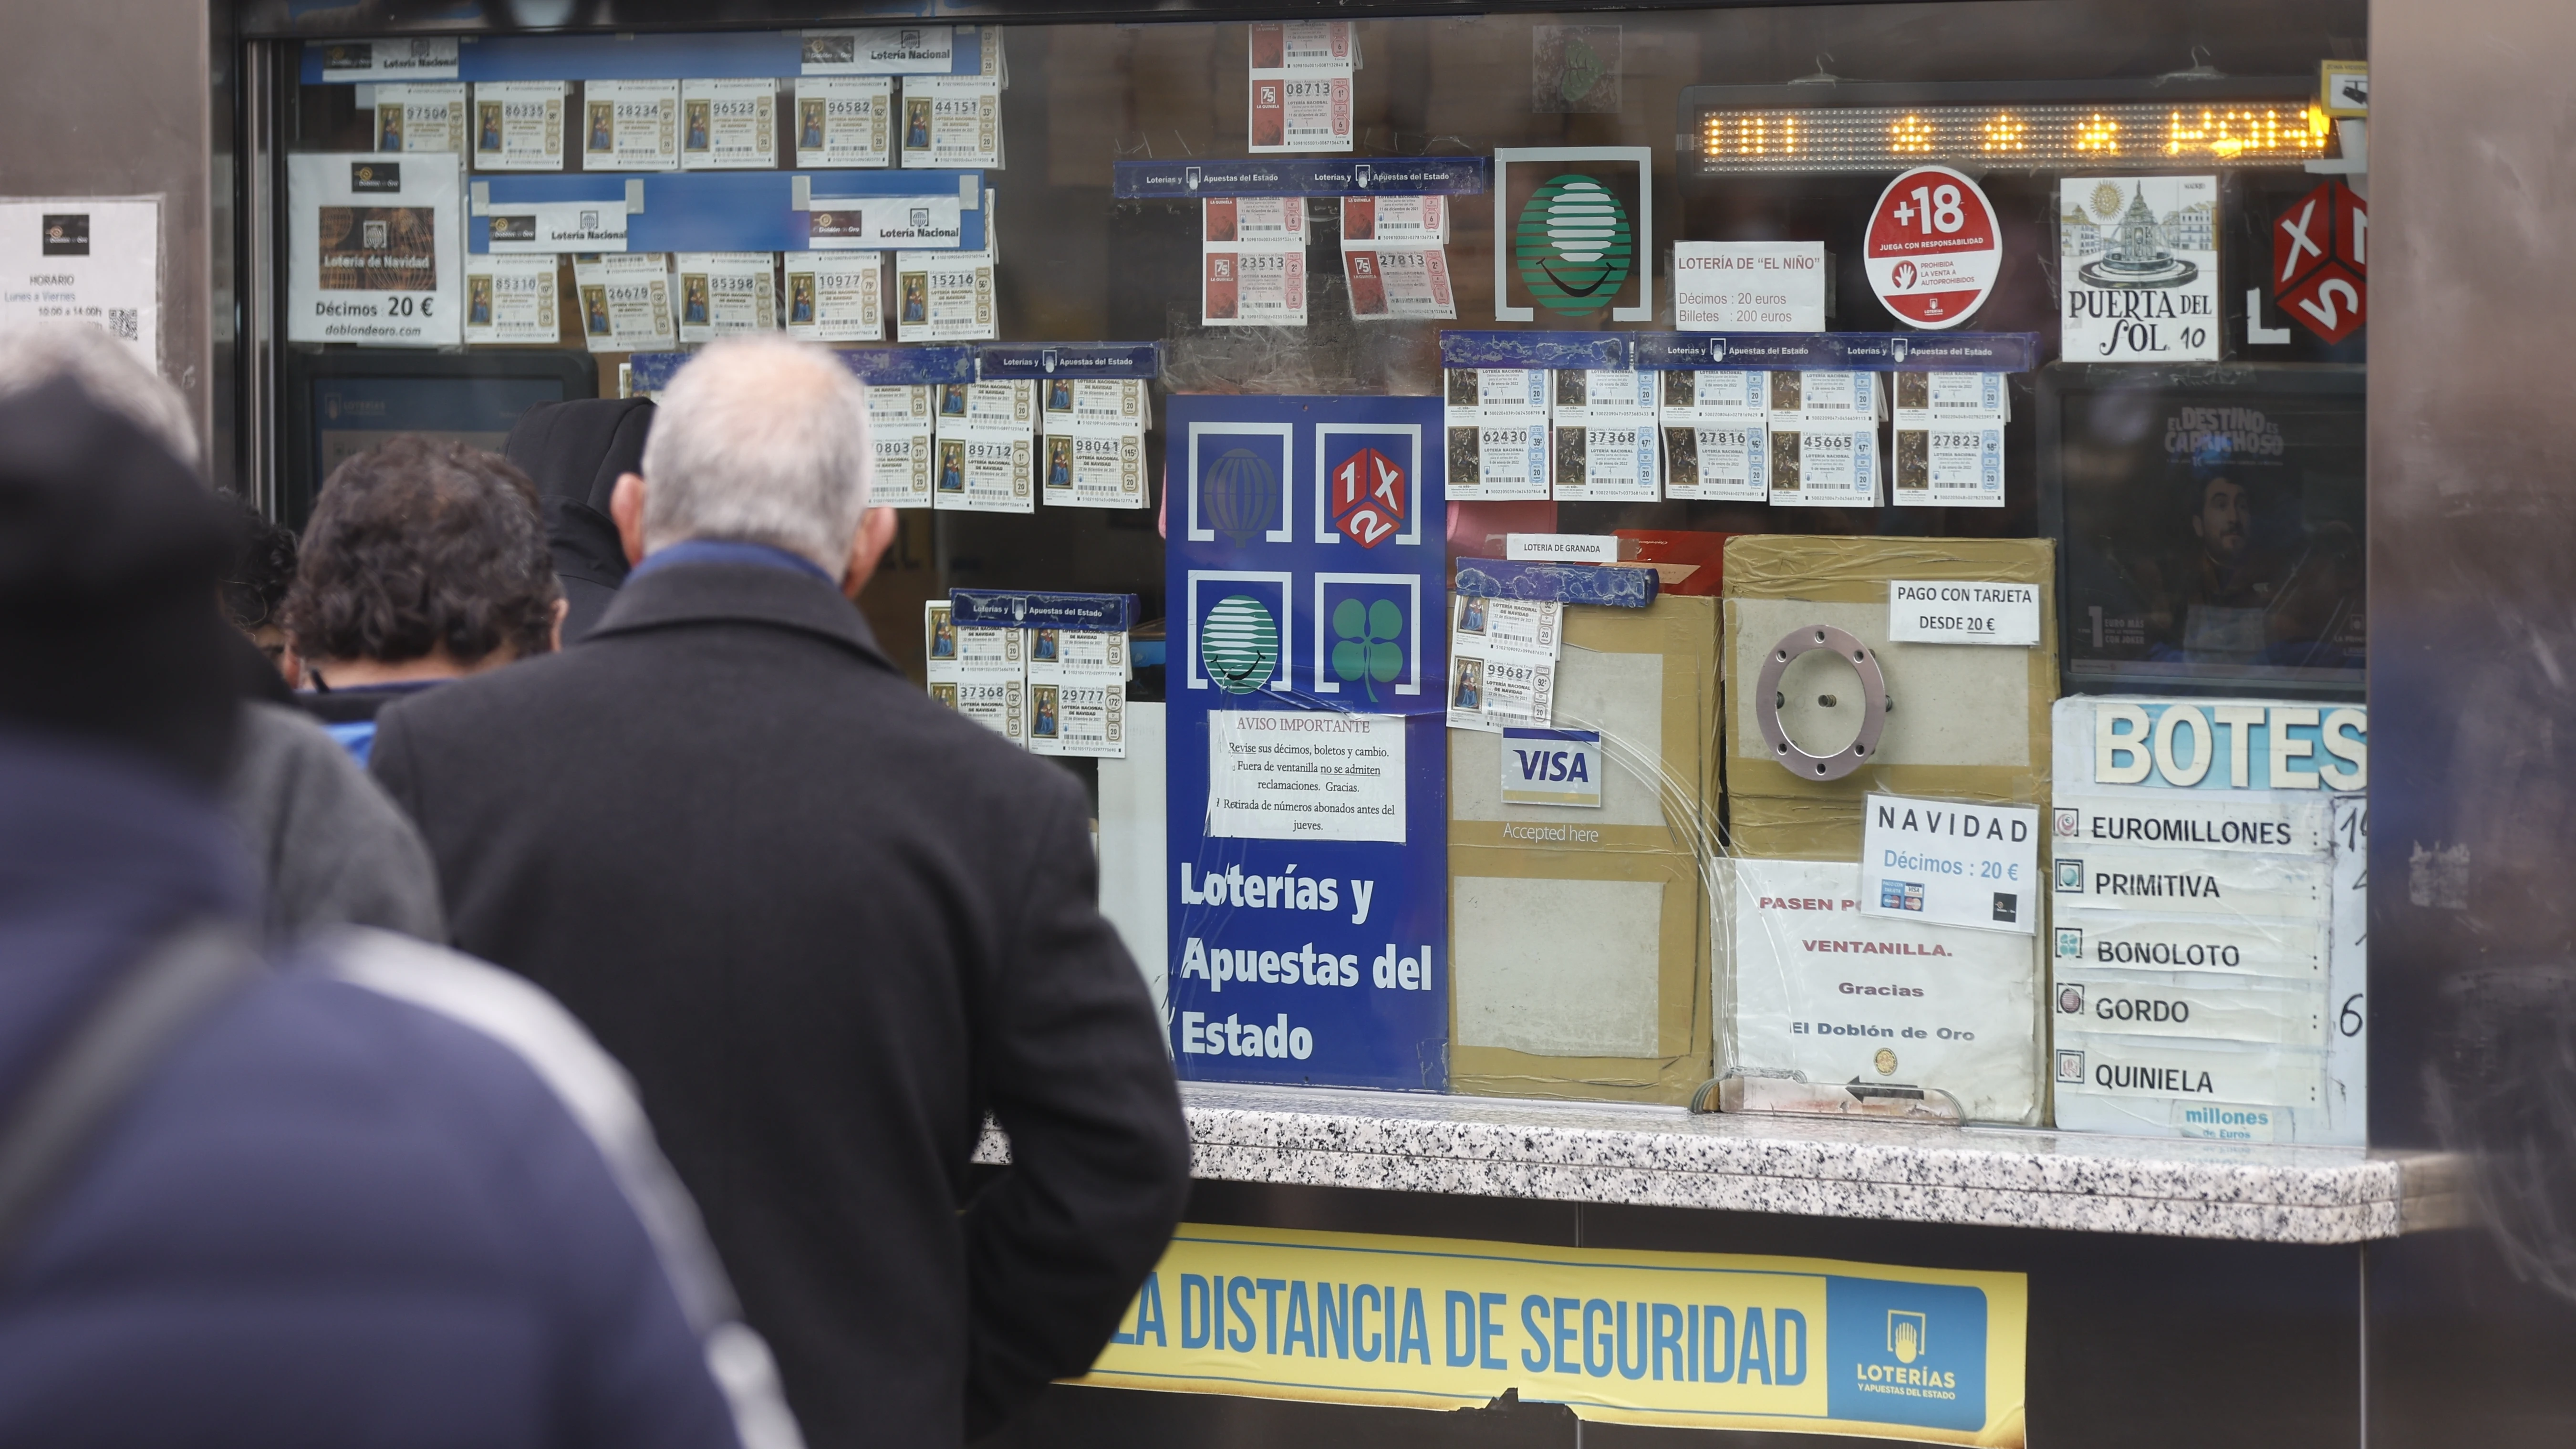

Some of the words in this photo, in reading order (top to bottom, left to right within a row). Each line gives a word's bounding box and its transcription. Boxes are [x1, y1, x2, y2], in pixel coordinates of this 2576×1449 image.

[871, 50, 905, 60] Lotería
[909, 50, 950, 59] Nacional
[1287, 83, 1330, 94] 08713
[714, 103, 754, 114] 96523
[829, 102, 870, 113] 96582
[935, 102, 976, 112] 44151
[1373, 173, 1407, 181] Apuestas
[1894, 184, 1964, 234] +18
[880, 228, 915, 238] Lotería
[917, 228, 958, 237] Nacional
[1922, 238, 1983, 248] RESPONSABILIDAD
[325, 256, 364, 268] Lotería
[367, 256, 380, 268] de
[384, 256, 428, 269] Navidad
[1241, 257, 1284, 268] 23513
[1380, 255, 1424, 266] 27813
[1679, 255, 1733, 269] LOTERÍA
[1737, 259, 1754, 269] DE
[30, 275, 74, 286] HORARIO
[819, 275, 859, 286] 10977
[931, 274, 973, 285] 15216
[1921, 276, 1974, 286] AUTOPROHIBIDOS
[1679, 292, 1727, 305] Décimos
[1738, 293, 1752, 305] 20
[1755, 295, 1786, 305] euros
[316, 301, 377, 317] Décimos
[388, 297, 413, 316] 20
[421, 297, 434, 317] €
[2068, 290, 2177, 321] PUERTA
[2180, 295, 2212, 315] DEL
[1679, 310, 1719, 322] Billetes
[1736, 310, 1756, 322] 200
[1761, 313, 1791, 322] euros
[325, 325, 421, 336] doblondeoro.com
[2181, 327, 2205, 350] 10
[1729, 347, 1765, 355] Apuestas
[1911, 348, 1948, 356] Apuestas
[1060, 358, 1093, 366] Apuestas
[1484, 431, 1527, 442] 62430
[1589, 432, 1635, 443] 37368
[1700, 431, 1745, 443] 27816
[1804, 437, 1851, 447] 45665
[1933, 436, 1979, 446] 27823
[969, 445, 1010, 456] 89712
[1076, 440, 1119, 451] 98041
[1375, 456, 1398, 511] X
[1524, 544, 1553, 553] LOTERIA
[1555, 544, 1564, 552] DE
[1566, 544, 1600, 553] GRANADA
[1898, 587, 1937, 600] PAGO
[1941, 588, 1970, 601] CON
[1974, 589, 2032, 603] TARJETA
[1920, 616, 1963, 630] DESDE
[1967, 618, 1983, 631] 20
[1986, 618, 1995, 631] €
[1487, 664, 1533, 679] 99687
[961, 687, 1003, 698] 37368
[1062, 690, 1103, 700] 29777
[1236, 717, 1277, 731] AVISO
[1279, 719, 1370, 733] IMPORTANTE
[1229, 742, 1256, 753] Revise
[1258, 744, 1272, 754] sus
[1274, 743, 1312, 756] décimos,
[1314, 744, 1345, 756] boletos
[1347, 747, 1353, 758] y
[1355, 745, 1389, 757] cambio.
[2095, 704, 2367, 792] BOTES
[1237, 761, 1263, 771] Fuera
[1264, 761, 1274, 771] de
[1276, 762, 1318, 773] ventanilla
[1320, 764, 1331, 773] no
[1333, 765, 1342, 774] se
[1345, 764, 1380, 775] admiten
[1513, 749, 1589, 783] VISA
[1257, 780, 1320, 792] reclamaciones.
[1325, 782, 1360, 793] Gracias.
[1224, 799, 1259, 811] Retirada
[1261, 800, 1271, 811] de
[1273, 800, 1311, 813] números
[1314, 802, 1354, 814] abonados
[1356, 803, 1380, 814] antes
[1381, 803, 1395, 815] del
[1293, 819, 1323, 832] jueves.
[1879, 806, 2027, 842] NAVIDAD
[2092, 816, 2291, 845] EUROMILLONES
[1503, 823, 1568, 842] Accepted
[1569, 824, 1599, 842] here
[1884, 850, 1962, 875] Décimos
[1981, 860, 2002, 879] 20
[2007, 864, 2018, 880] €
[2096, 873, 2220, 898] PRIMITIVA
[1181, 863, 1338, 911] Loterías
[1351, 880, 1374, 925] y
[1760, 897, 1833, 911] PASEN
[1802, 939, 1952, 957] VENTANILLA.
[2098, 941, 2239, 967] BONOLOTO
[1180, 937, 1359, 993] Apuestas
[1372, 943, 1432, 991] del
[1839, 983, 1924, 997] Gracias
[2096, 998, 2189, 1023] GORDO
[1182, 1011, 1313, 1060] Estado
[1792, 1022, 1808, 1034] El
[1818, 1023, 1894, 1037] Doblón
[1901, 1026, 1927, 1039] de
[1936, 1028, 1975, 1041] Oro
[2096, 1064, 2213, 1093] QUINIELA
[2186, 1107, 2268, 1126] millones
[2203, 1129, 2216, 1138] de
[2219, 1128, 2251, 1138] Euros
[1181, 1273, 1431, 1365] DISTANCIA
[1445, 1290, 1507, 1369] DE
[1520, 1294, 1807, 1387] SEGURIDAD
[1857, 1363, 1955, 1388] LOTERÍAS
[1858, 1383, 1864, 1391] Y
[1865, 1384, 1905, 1396] APUESTAS
[1906, 1388, 1921, 1397] DEL
[1923, 1389, 1956, 1400] ESTADO
